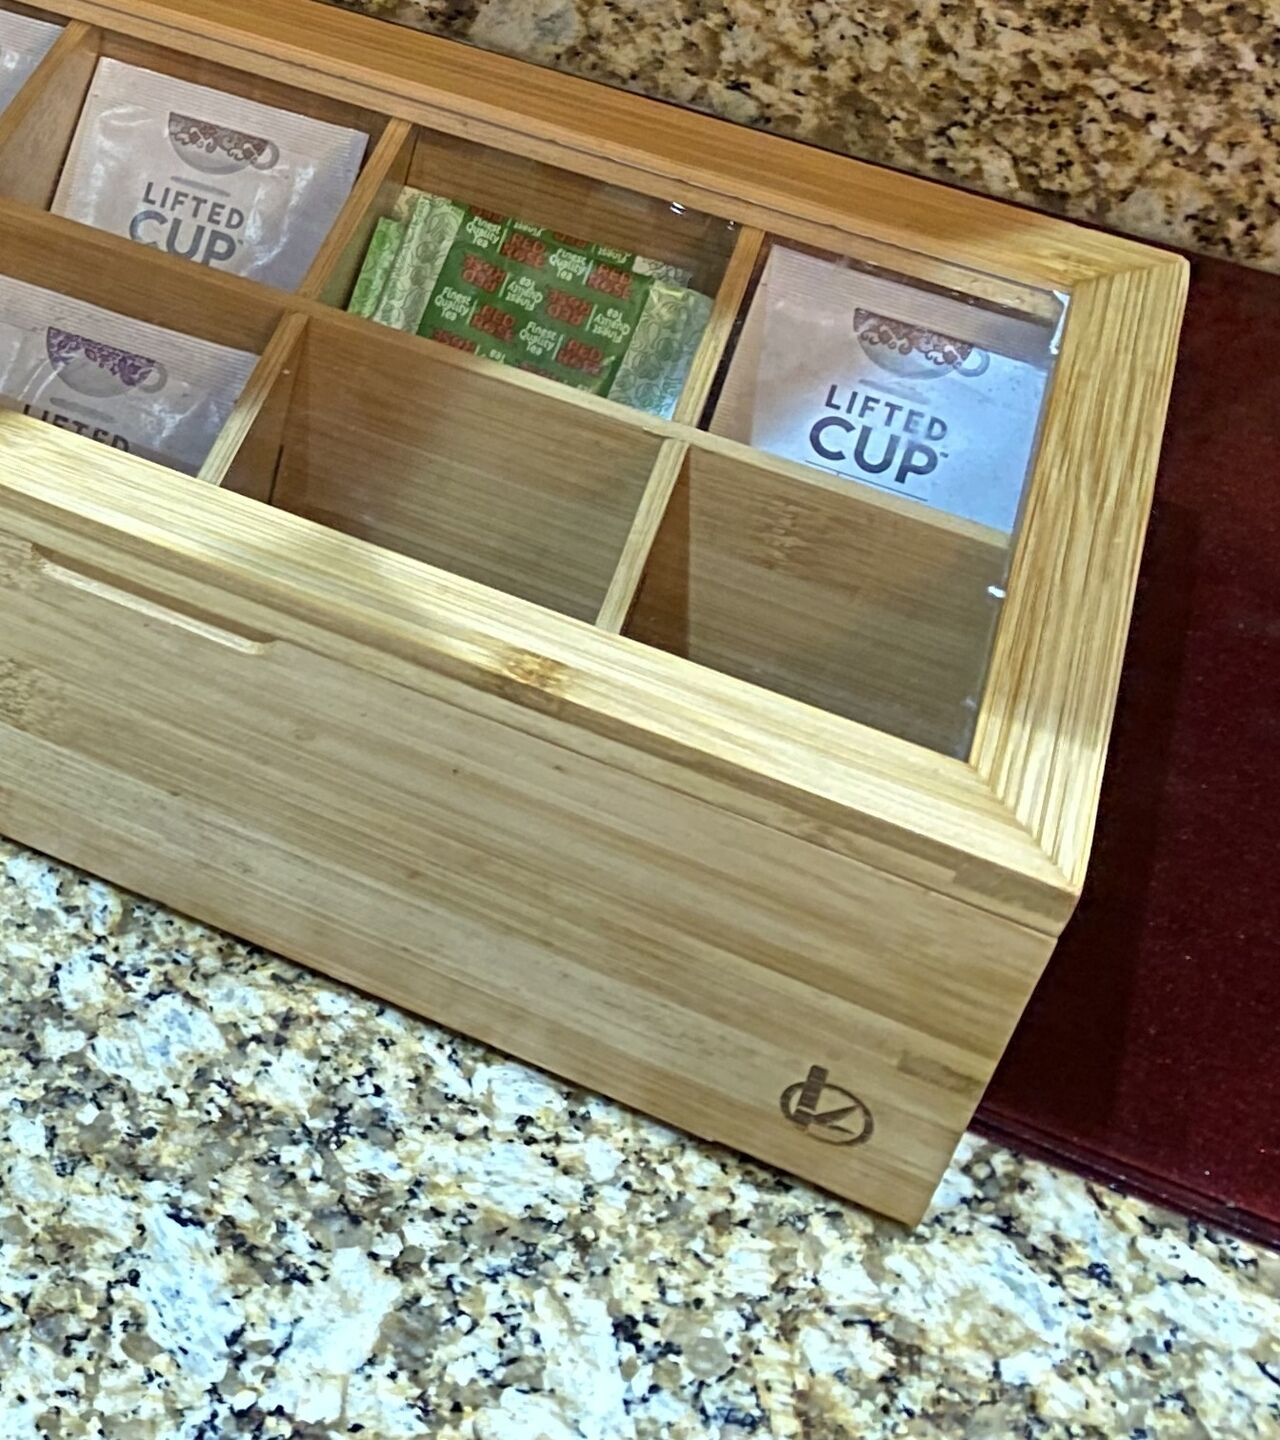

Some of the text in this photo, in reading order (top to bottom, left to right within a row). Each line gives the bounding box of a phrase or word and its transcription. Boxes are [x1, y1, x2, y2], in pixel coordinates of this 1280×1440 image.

[142, 182, 245, 230] LIFTED
[466, 221, 500, 244] Quality
[473, 216, 502, 235] Finest
[130, 210, 236, 266] CUP
[473, 235, 489, 248] Tea
[511, 232, 546, 254] RED
[548, 254, 586, 276] Quality
[557, 248, 587, 267] Finest
[556, 268, 573, 282] Tea
[596, 263, 633, 285] RED
[434, 294, 469, 316] Quality
[441, 286, 472, 306] Finest
[441, 306, 458, 322] Tea
[481, 304, 516, 327] RED
[519, 329, 555, 351] Quality
[527, 321, 557, 340] Finest
[526, 341, 543, 356] Tea
[566, 338, 603, 360] RED
[825, 384, 948, 442] LIFTED
[809, 416, 938, 484] CUP
